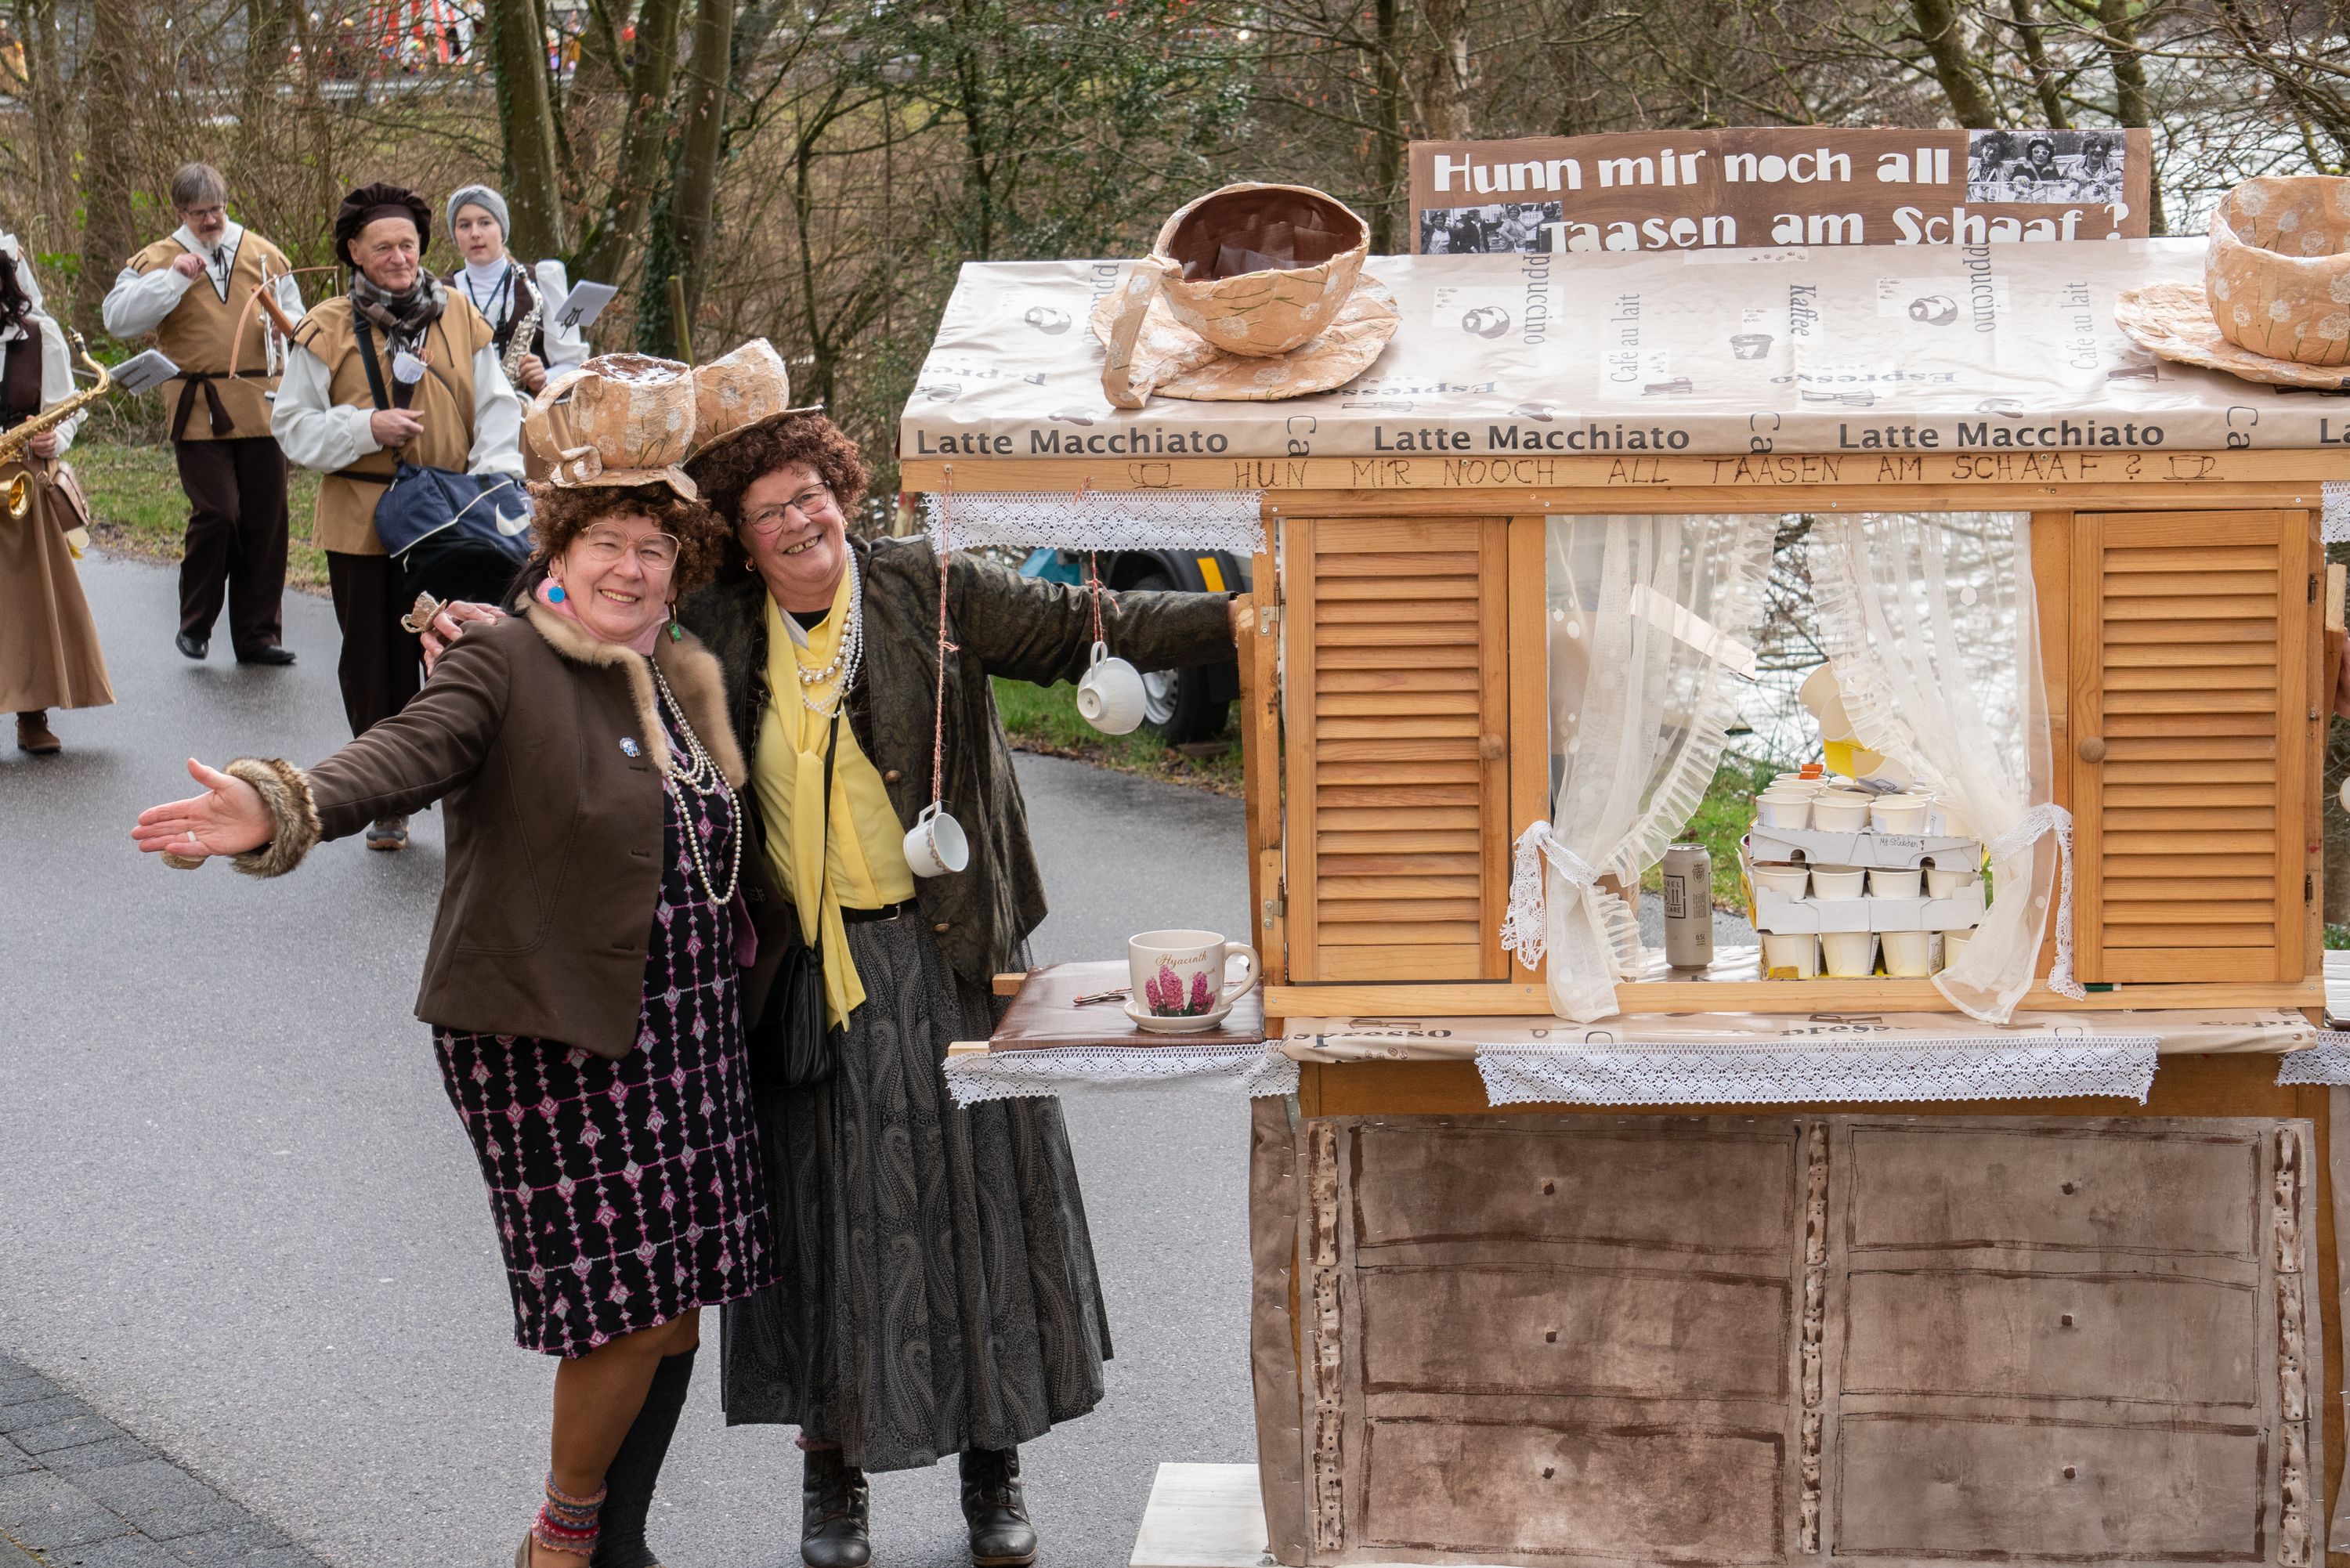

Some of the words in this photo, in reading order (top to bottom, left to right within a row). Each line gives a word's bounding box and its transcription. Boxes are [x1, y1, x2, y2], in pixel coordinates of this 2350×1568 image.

[1434, 154, 1582, 194] Hunn
[1598, 148, 1706, 188] mir
[1724, 148, 1851, 183] noch
[1877, 148, 1950, 185] all
[1540, 215, 1737, 253] Taasen
[1771, 213, 1864, 245] am
[1893, 206, 2084, 245] Schaaf
[2104, 202, 2129, 240] ?
[1522, 251, 1553, 345] ppuccino
[1962, 242, 2001, 333] ppuccino
[2060, 281, 2090, 309] lait
[1611, 293, 1640, 323] lait
[1790, 284, 1819, 337] Kaffee
[2073, 314, 2094, 332] au
[1622, 327, 1639, 346] au
[1609, 351, 1639, 382] Café
[2065, 338, 2099, 370] Café
[918, 429, 1013, 455] Latte
[1030, 427, 1228, 454] Macchiato
[1375, 426, 1471, 451] Latte
[1488, 423, 1690, 450] Macchiato
[1839, 423, 1940, 449] Latte
[1958, 420, 2164, 447] Macchiato
[1235, 461, 1308, 489] HUN
[1353, 459, 1411, 486] MIR
[1444, 458, 1555, 485] NOOCH
[1608, 457, 1670, 484] ALL
[1703, 456, 1844, 483] TAASEN
[1878, 456, 1922, 482] AM
[1952, 453, 2102, 480] SCHAAF
[2125, 453, 2141, 479] ?
[1155, 951, 1208, 970] Hyacinth
